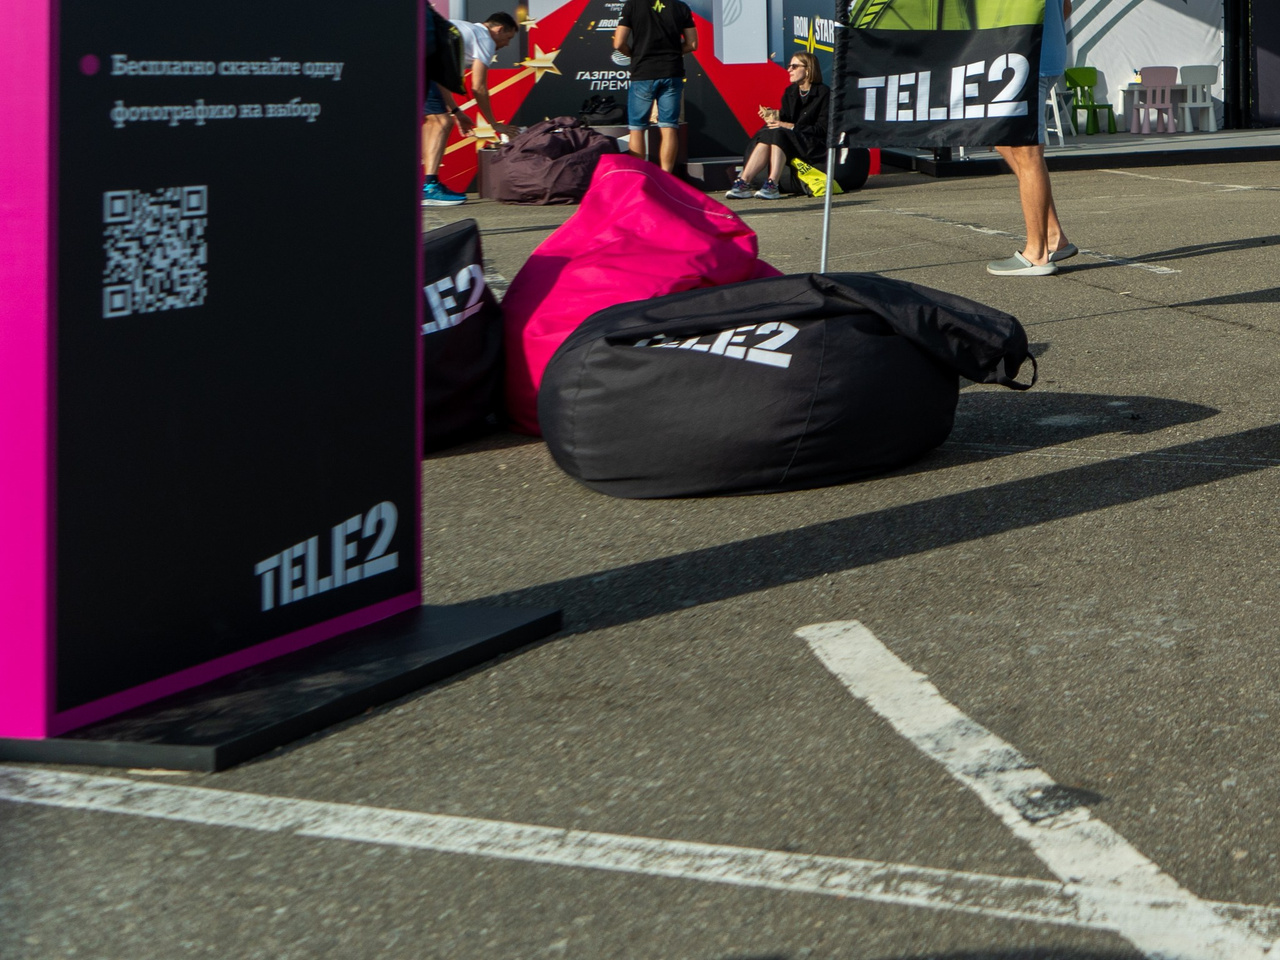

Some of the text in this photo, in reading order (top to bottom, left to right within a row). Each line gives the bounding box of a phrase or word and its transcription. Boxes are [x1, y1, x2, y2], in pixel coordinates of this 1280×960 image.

[793, 15, 834, 44] IRON STAR
[111, 54, 345, 81] Бесплатно скачайте одну
[575, 71, 631, 80] ГАЗПРО
[590, 80, 631, 90] ПРЕМ
[858, 52, 1029, 123] TELE2
[110, 97, 321, 129] фотографию на выбор
[254, 500, 399, 612] TELE2
